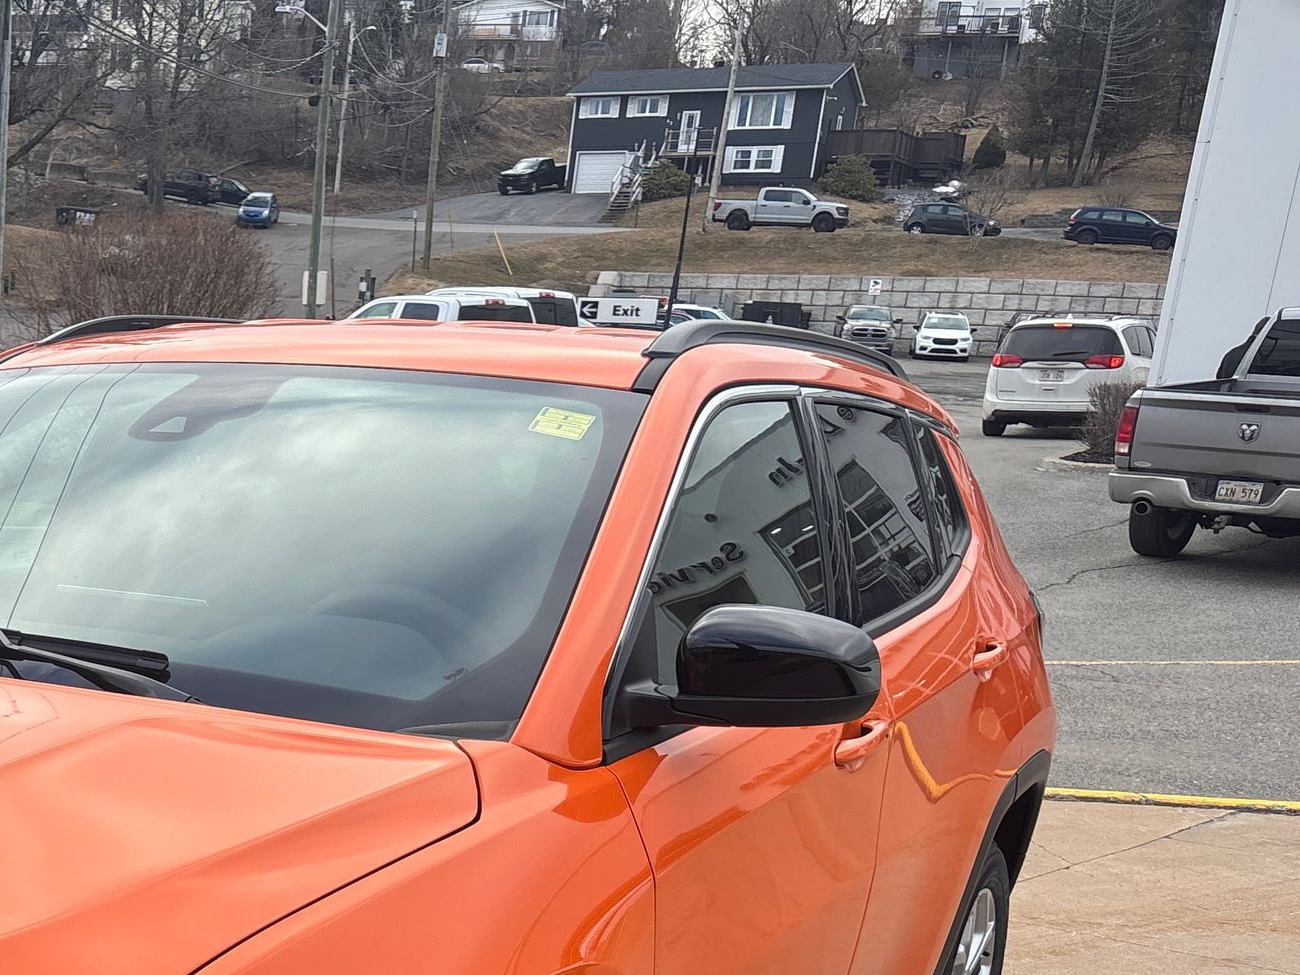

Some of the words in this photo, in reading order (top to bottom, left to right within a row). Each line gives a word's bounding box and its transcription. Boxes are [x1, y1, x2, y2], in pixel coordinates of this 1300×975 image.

[612, 305, 640, 317] Exit
[1218, 486, 1236, 498] CXN
[1240, 487, 1259, 499] 579
